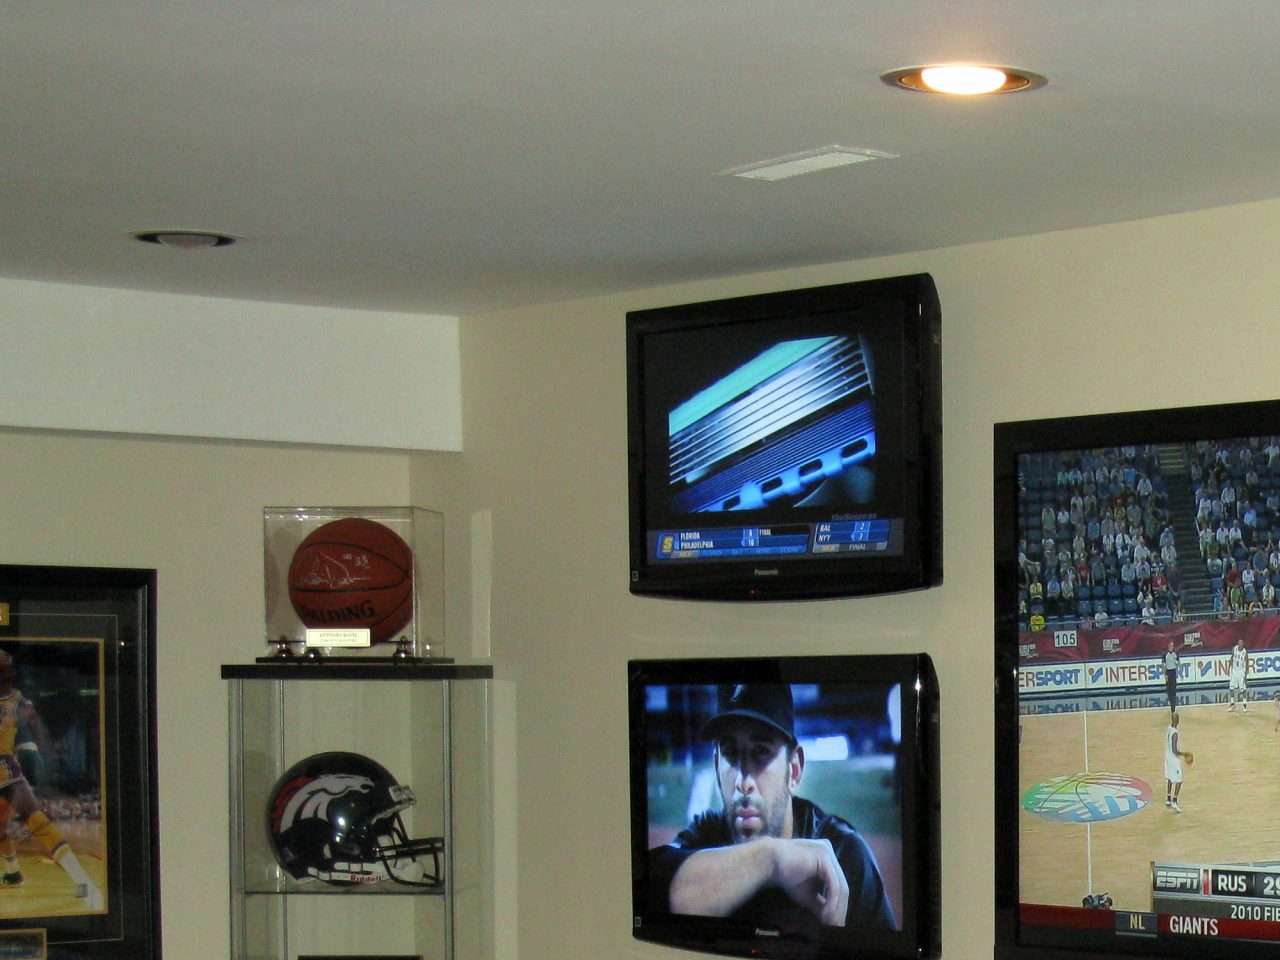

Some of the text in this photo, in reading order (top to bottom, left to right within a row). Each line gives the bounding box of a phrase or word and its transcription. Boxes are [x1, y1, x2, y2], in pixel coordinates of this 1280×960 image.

[1055, 633, 1077, 647] 105
[1156, 871, 1199, 890] ESPN
[1217, 874, 1248, 893] RUS
[1230, 904, 1261, 922] 2010
[1130, 914, 1145, 930] NL
[1169, 915, 1219, 936] GIANTS
